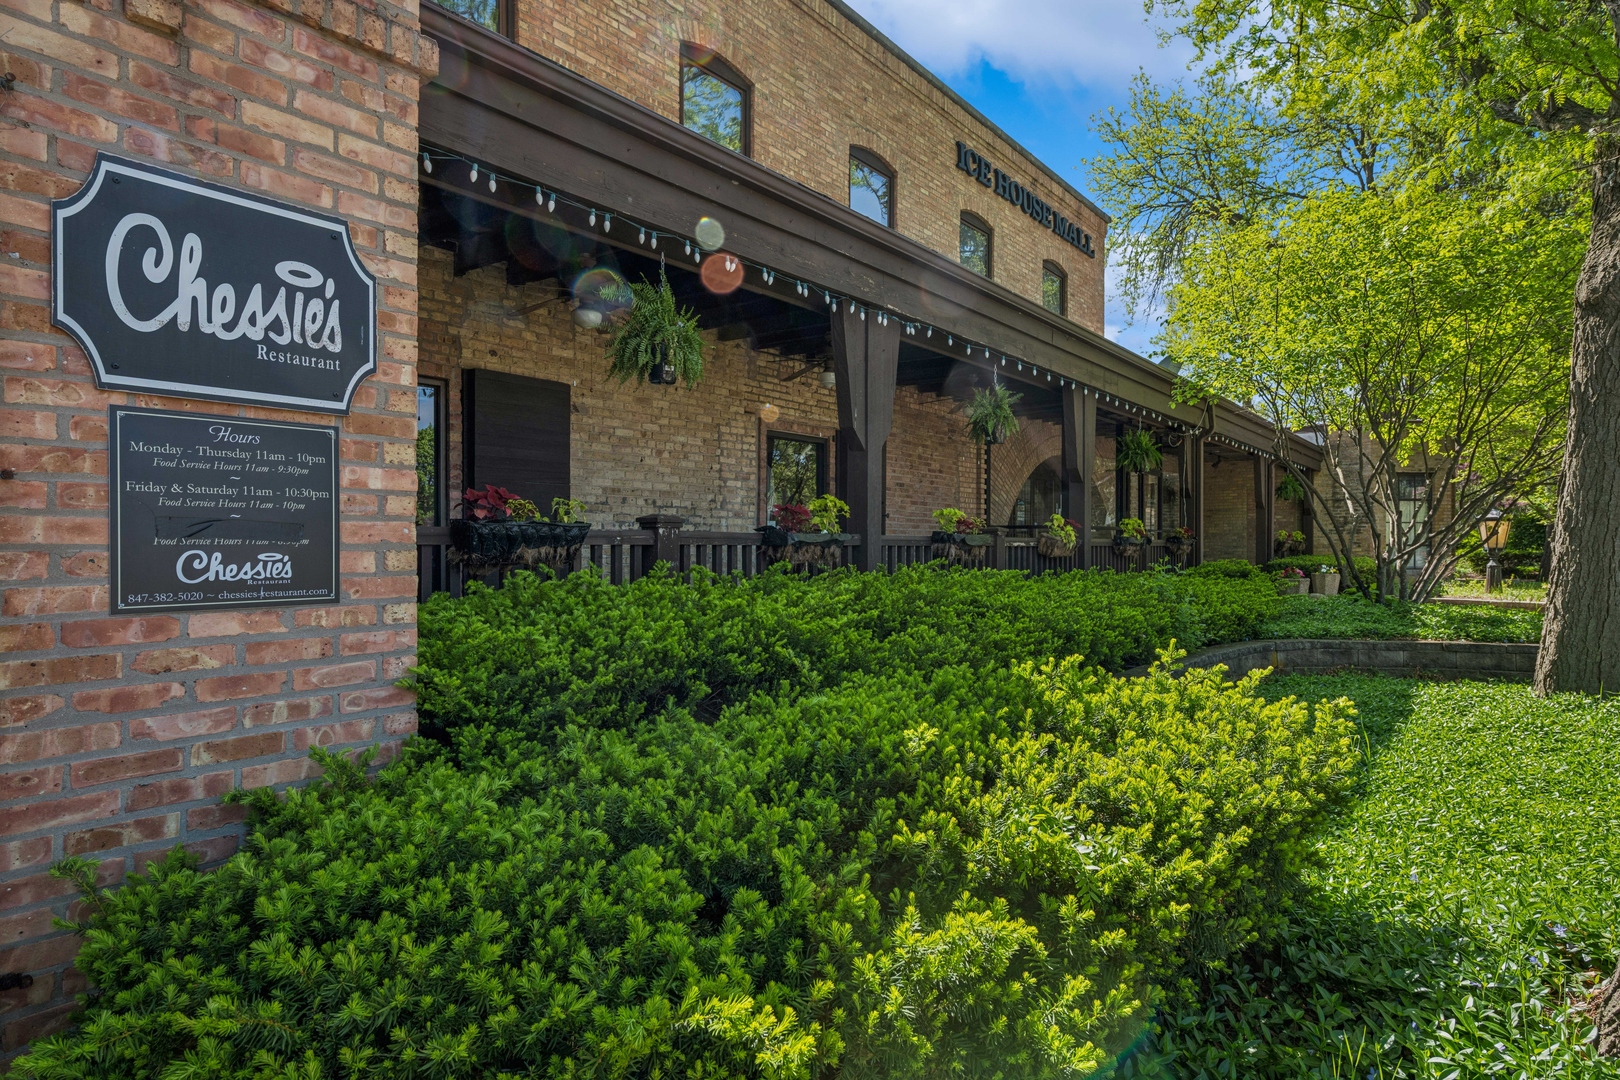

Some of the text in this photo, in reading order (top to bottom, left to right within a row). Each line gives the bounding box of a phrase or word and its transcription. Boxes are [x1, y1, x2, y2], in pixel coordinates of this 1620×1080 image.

[955, 140, 1095, 259] ICE HOUSE MALL
[105, 212, 342, 353] Chessie's
[256, 344, 341, 371] Restaurant
[208, 425, 261, 445] Hours
[129, 440, 184, 458] Monday
[195, 445, 252, 462] Thursday
[256, 450, 285, 461] 11am
[296, 453, 326, 466] 10pm
[152, 457, 178, 468] Food
[179, 459, 211, 470] Service
[213, 461, 242, 471] Hours
[245, 463, 270, 473] 11am
[277, 464, 309, 477] 9:30pm
[125, 480, 168, 496] Friday
[171, 483, 183, 494] &
[187, 483, 239, 498] Saturday
[243, 486, 273, 497] 11am
[285, 487, 330, 501] 10:30pm
[158, 497, 183, 507] Food
[184, 498, 216, 508] Service
[217, 499, 246, 509] Hours
[249, 500, 274, 509] 11am
[282, 501, 306, 512] 10pm
[176, 549, 293, 584] Chessie's
[127, 591, 204, 603] 847-382-5020
[218, 588, 328, 600] chessies-restaurant.com
